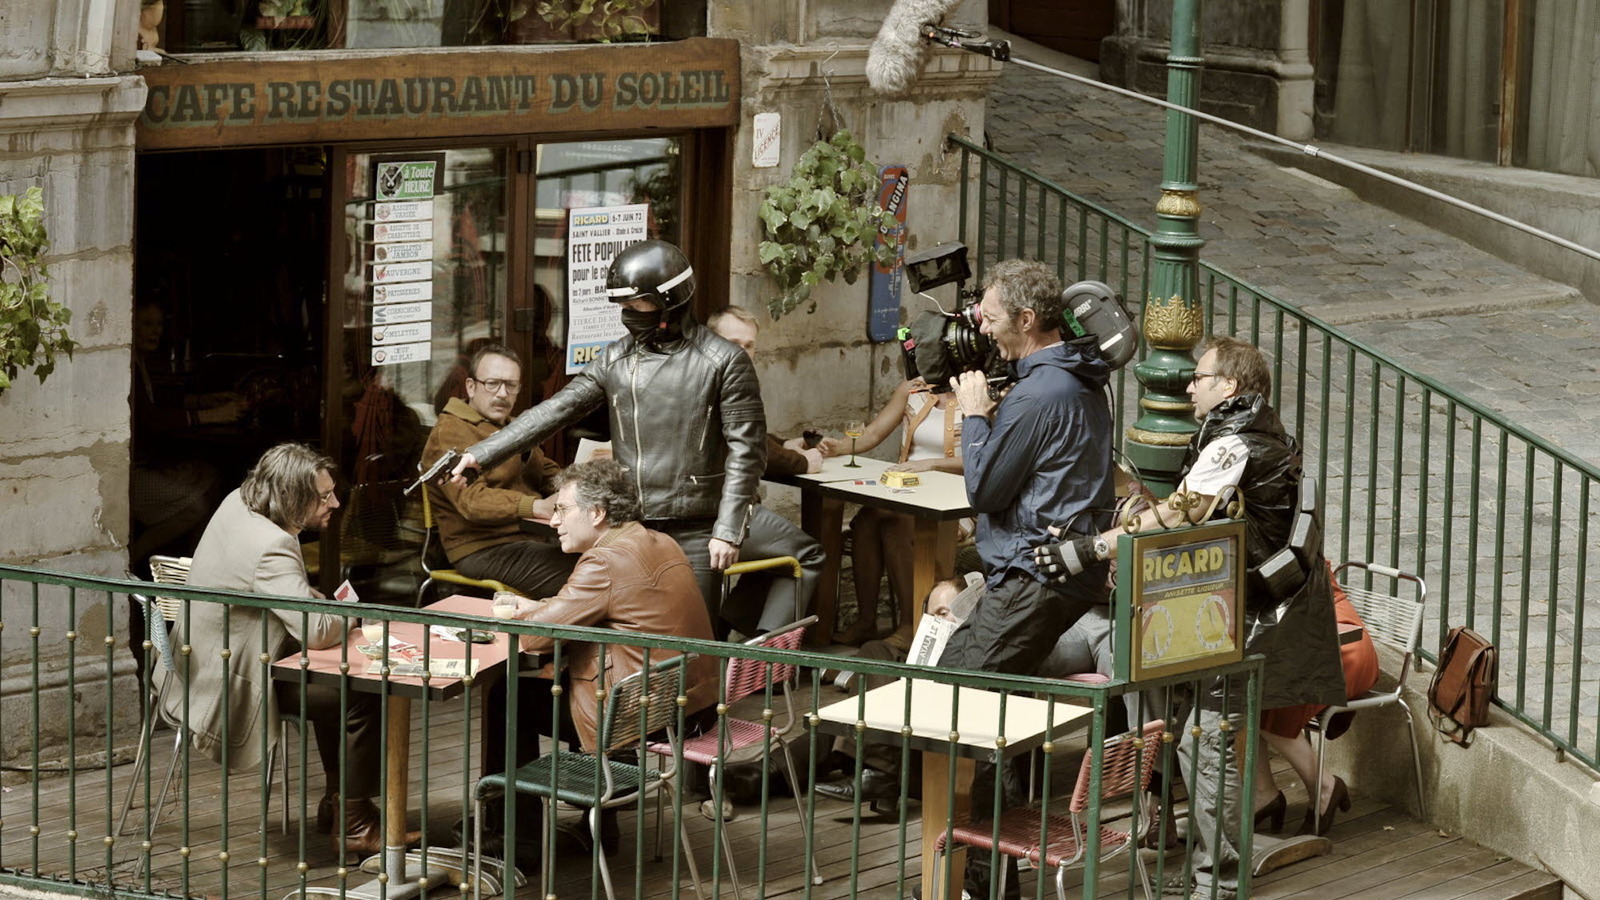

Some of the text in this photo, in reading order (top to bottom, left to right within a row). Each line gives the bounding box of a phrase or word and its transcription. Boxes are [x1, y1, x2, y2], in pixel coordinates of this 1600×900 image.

[145, 69, 731, 129] CAFE RESTAURANT DU SOLEIL
[411, 165, 434, 178] Toute
[404, 179, 431, 194] HEURE
[574, 215, 609, 226] RICARD
[623, 213, 634, 221] JUIN
[572, 231, 588, 239] SAINT
[590, 229, 611, 237] VALLIER
[392, 251, 419, 260] JAMBON
[572, 239, 643, 264] FETE POPUL
[386, 268, 421, 276] AUVERGNE
[572, 268, 589, 285] pour
[591, 265, 599, 281] le
[386, 307, 422, 315] CORNICHONS
[384, 329, 420, 338] OMELETTES
[1210, 445, 1238, 471] 36
[1143, 546, 1224, 583] RICARD
[1164, 582, 1224, 599] ANISETTE LIQUEUR
